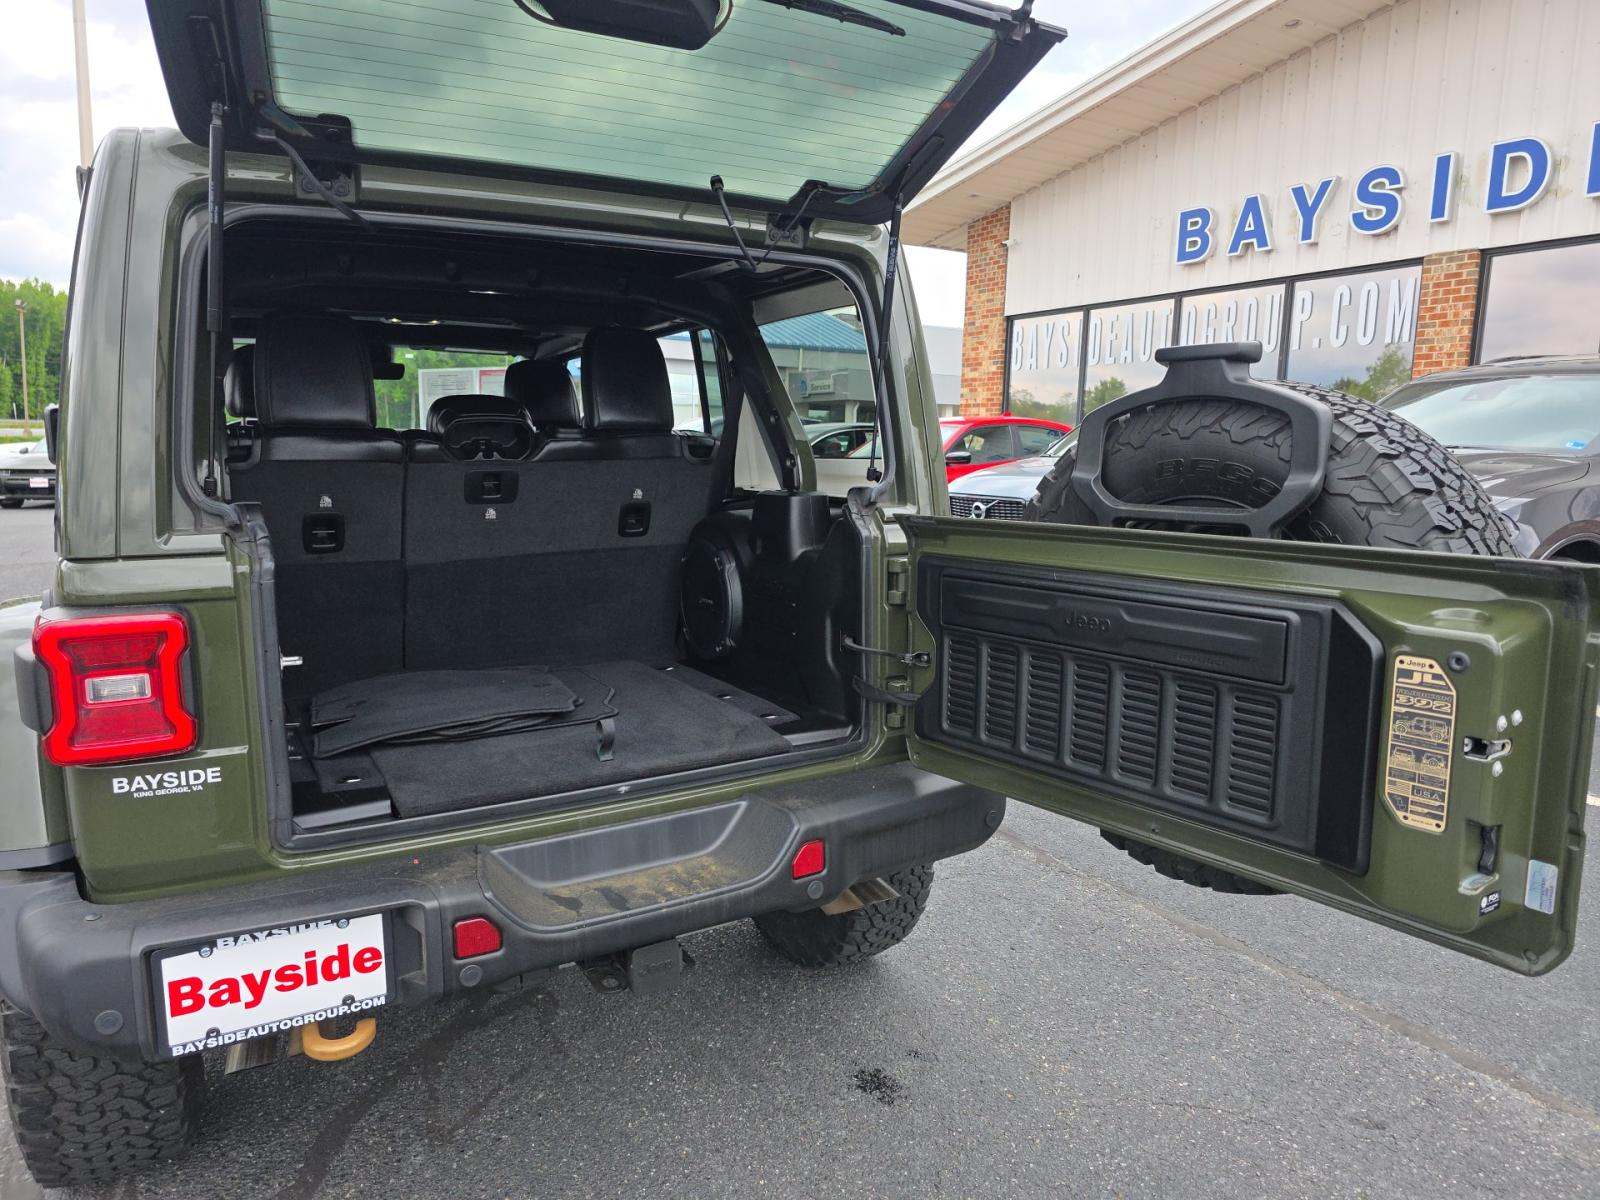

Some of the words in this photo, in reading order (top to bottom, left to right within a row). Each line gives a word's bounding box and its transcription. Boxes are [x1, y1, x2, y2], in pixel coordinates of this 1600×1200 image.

[112, 767, 222, 794] BAYSIDE
[133, 790, 154, 798] KING
[155, 787, 191, 796] GEORGE,
[168, 943, 383, 1018] Bayside
[172, 995, 386, 1057] BAYSIDEAUTOGROUP.COM
